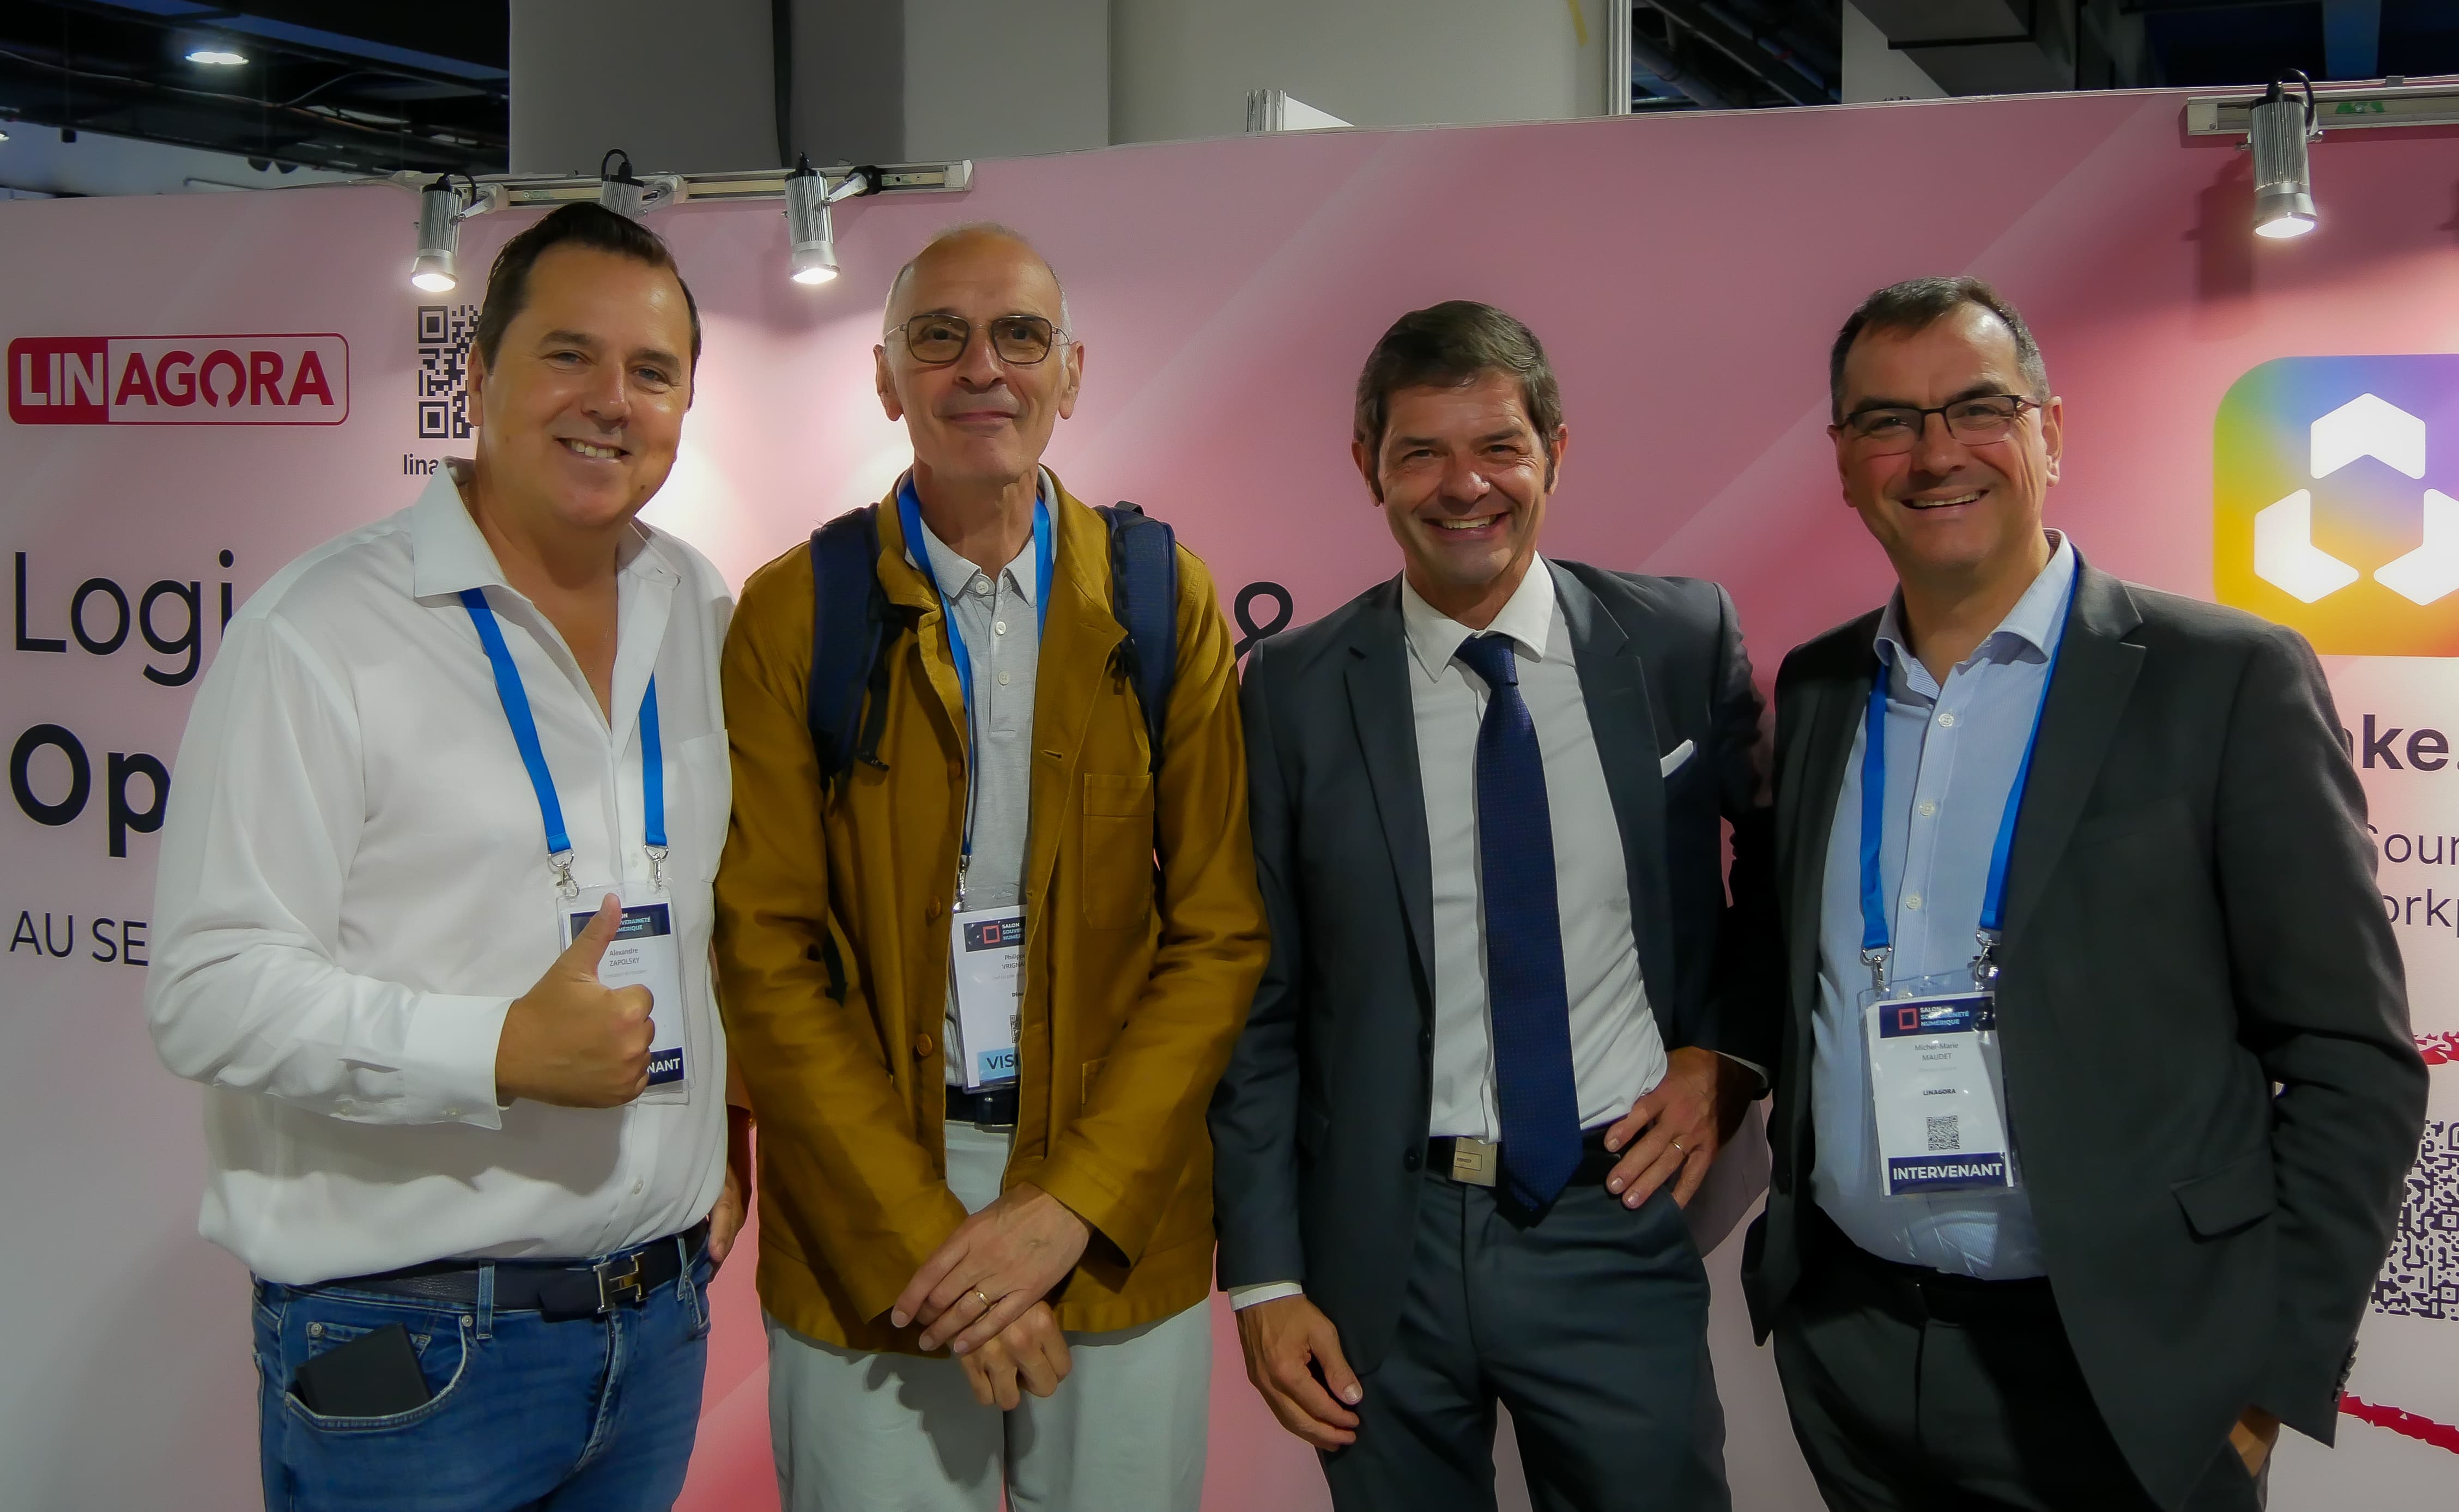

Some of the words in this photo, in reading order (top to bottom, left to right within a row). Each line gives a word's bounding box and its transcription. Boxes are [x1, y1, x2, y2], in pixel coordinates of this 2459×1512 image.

[20, 349, 335, 408] LINAGORA
[14, 549, 235, 687] Logi
[1234, 581, 1294, 663] &
[2343, 714, 2459, 772] ke
[9, 723, 171, 858] Op
[2367, 824, 2459, 865] our
[620, 916, 651, 925] VERAINETÉ
[2382, 888, 2459, 938] ork
[9, 910, 74, 958] AU
[92, 918, 149, 967] SE
[609, 948, 639, 956] Alexandre
[609, 957, 640, 967] ZAPOLSKY
[1002, 961, 1025, 969] VRIGNA
[1922, 1053, 1952, 1061] MAUDET
[1893, 1163, 2003, 1181] INTERVENANT
